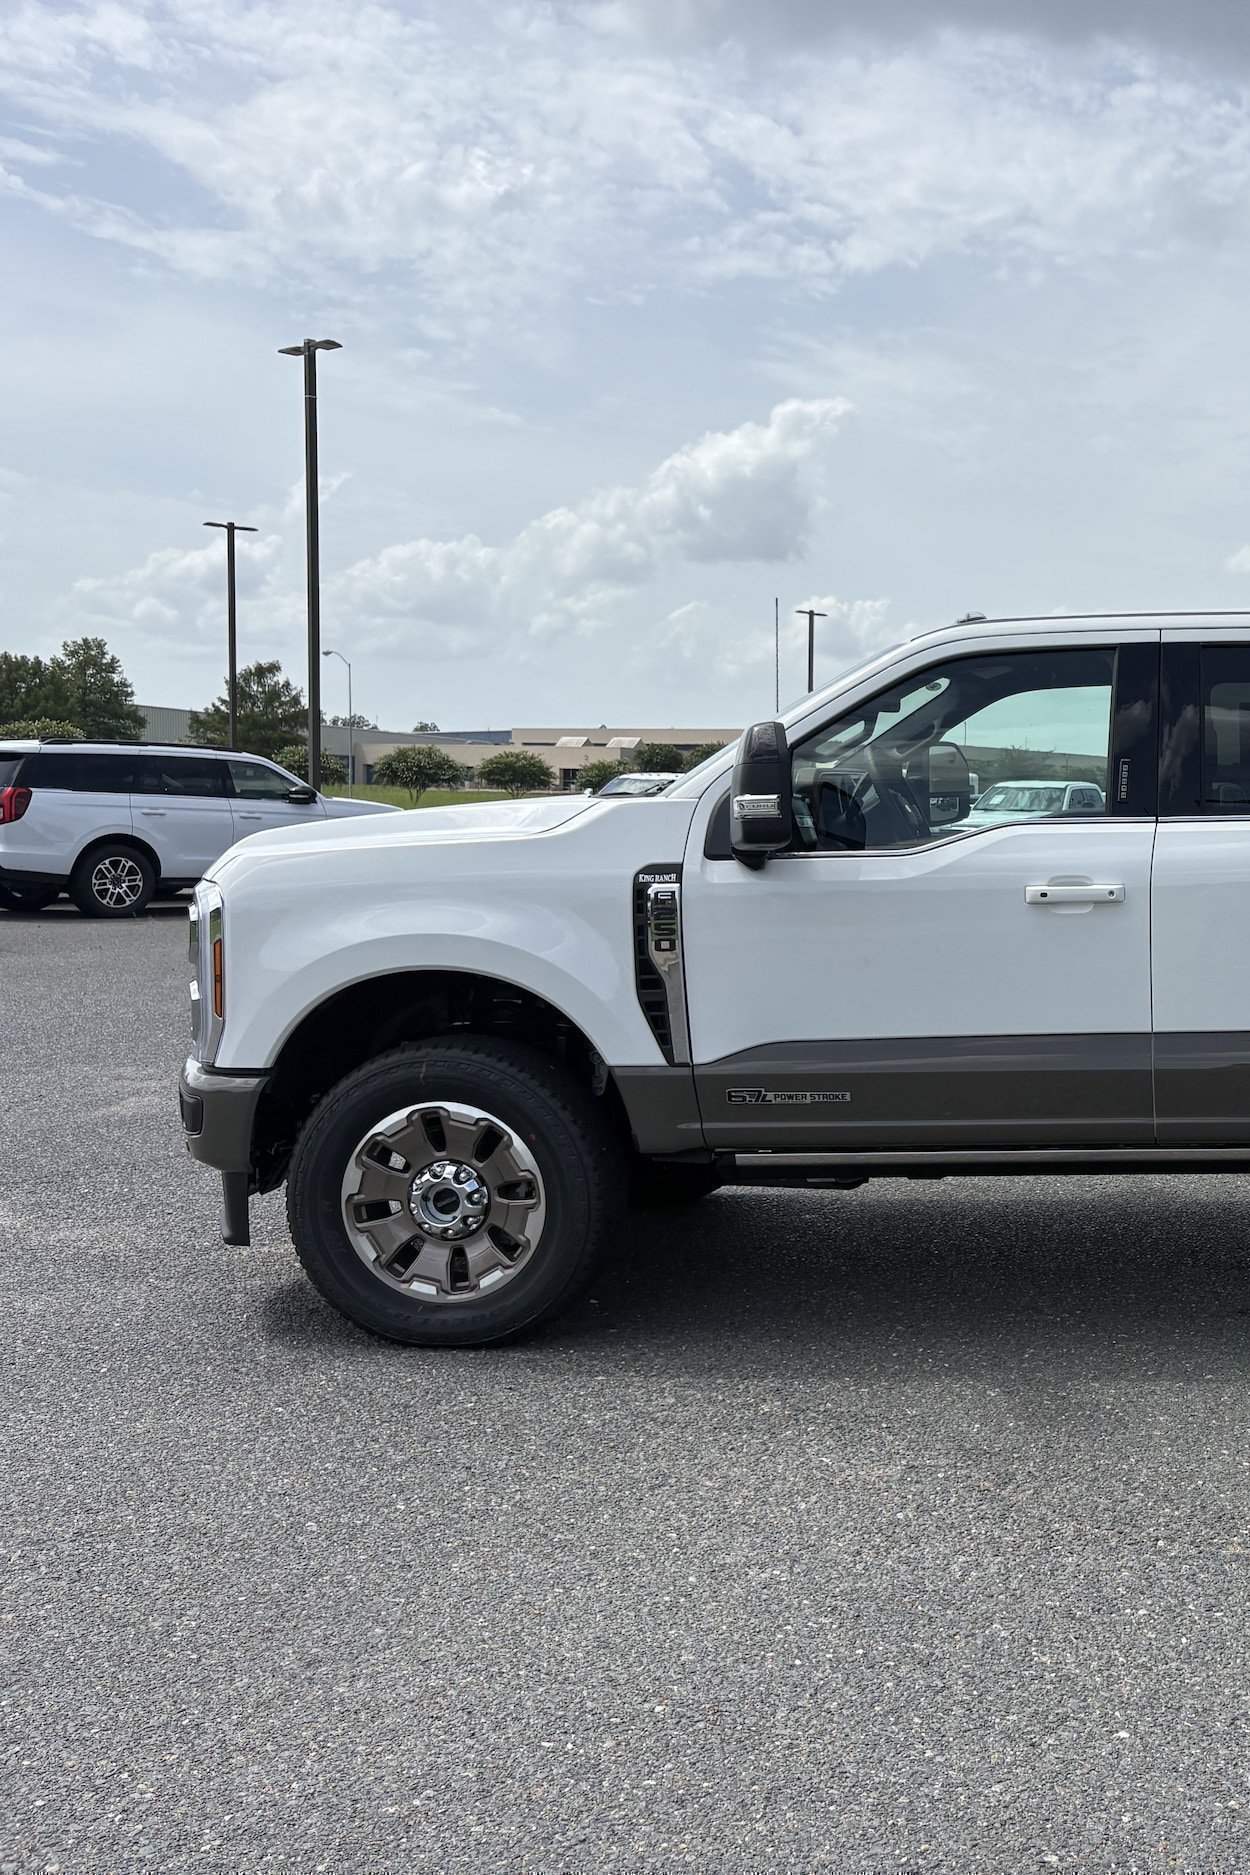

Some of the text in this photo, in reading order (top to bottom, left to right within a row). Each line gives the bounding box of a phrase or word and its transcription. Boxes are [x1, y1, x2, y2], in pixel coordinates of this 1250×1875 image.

[638, 873, 676, 882] KING RANCH
[727, 1089, 847, 1103] 6.7L POWER STROKE
